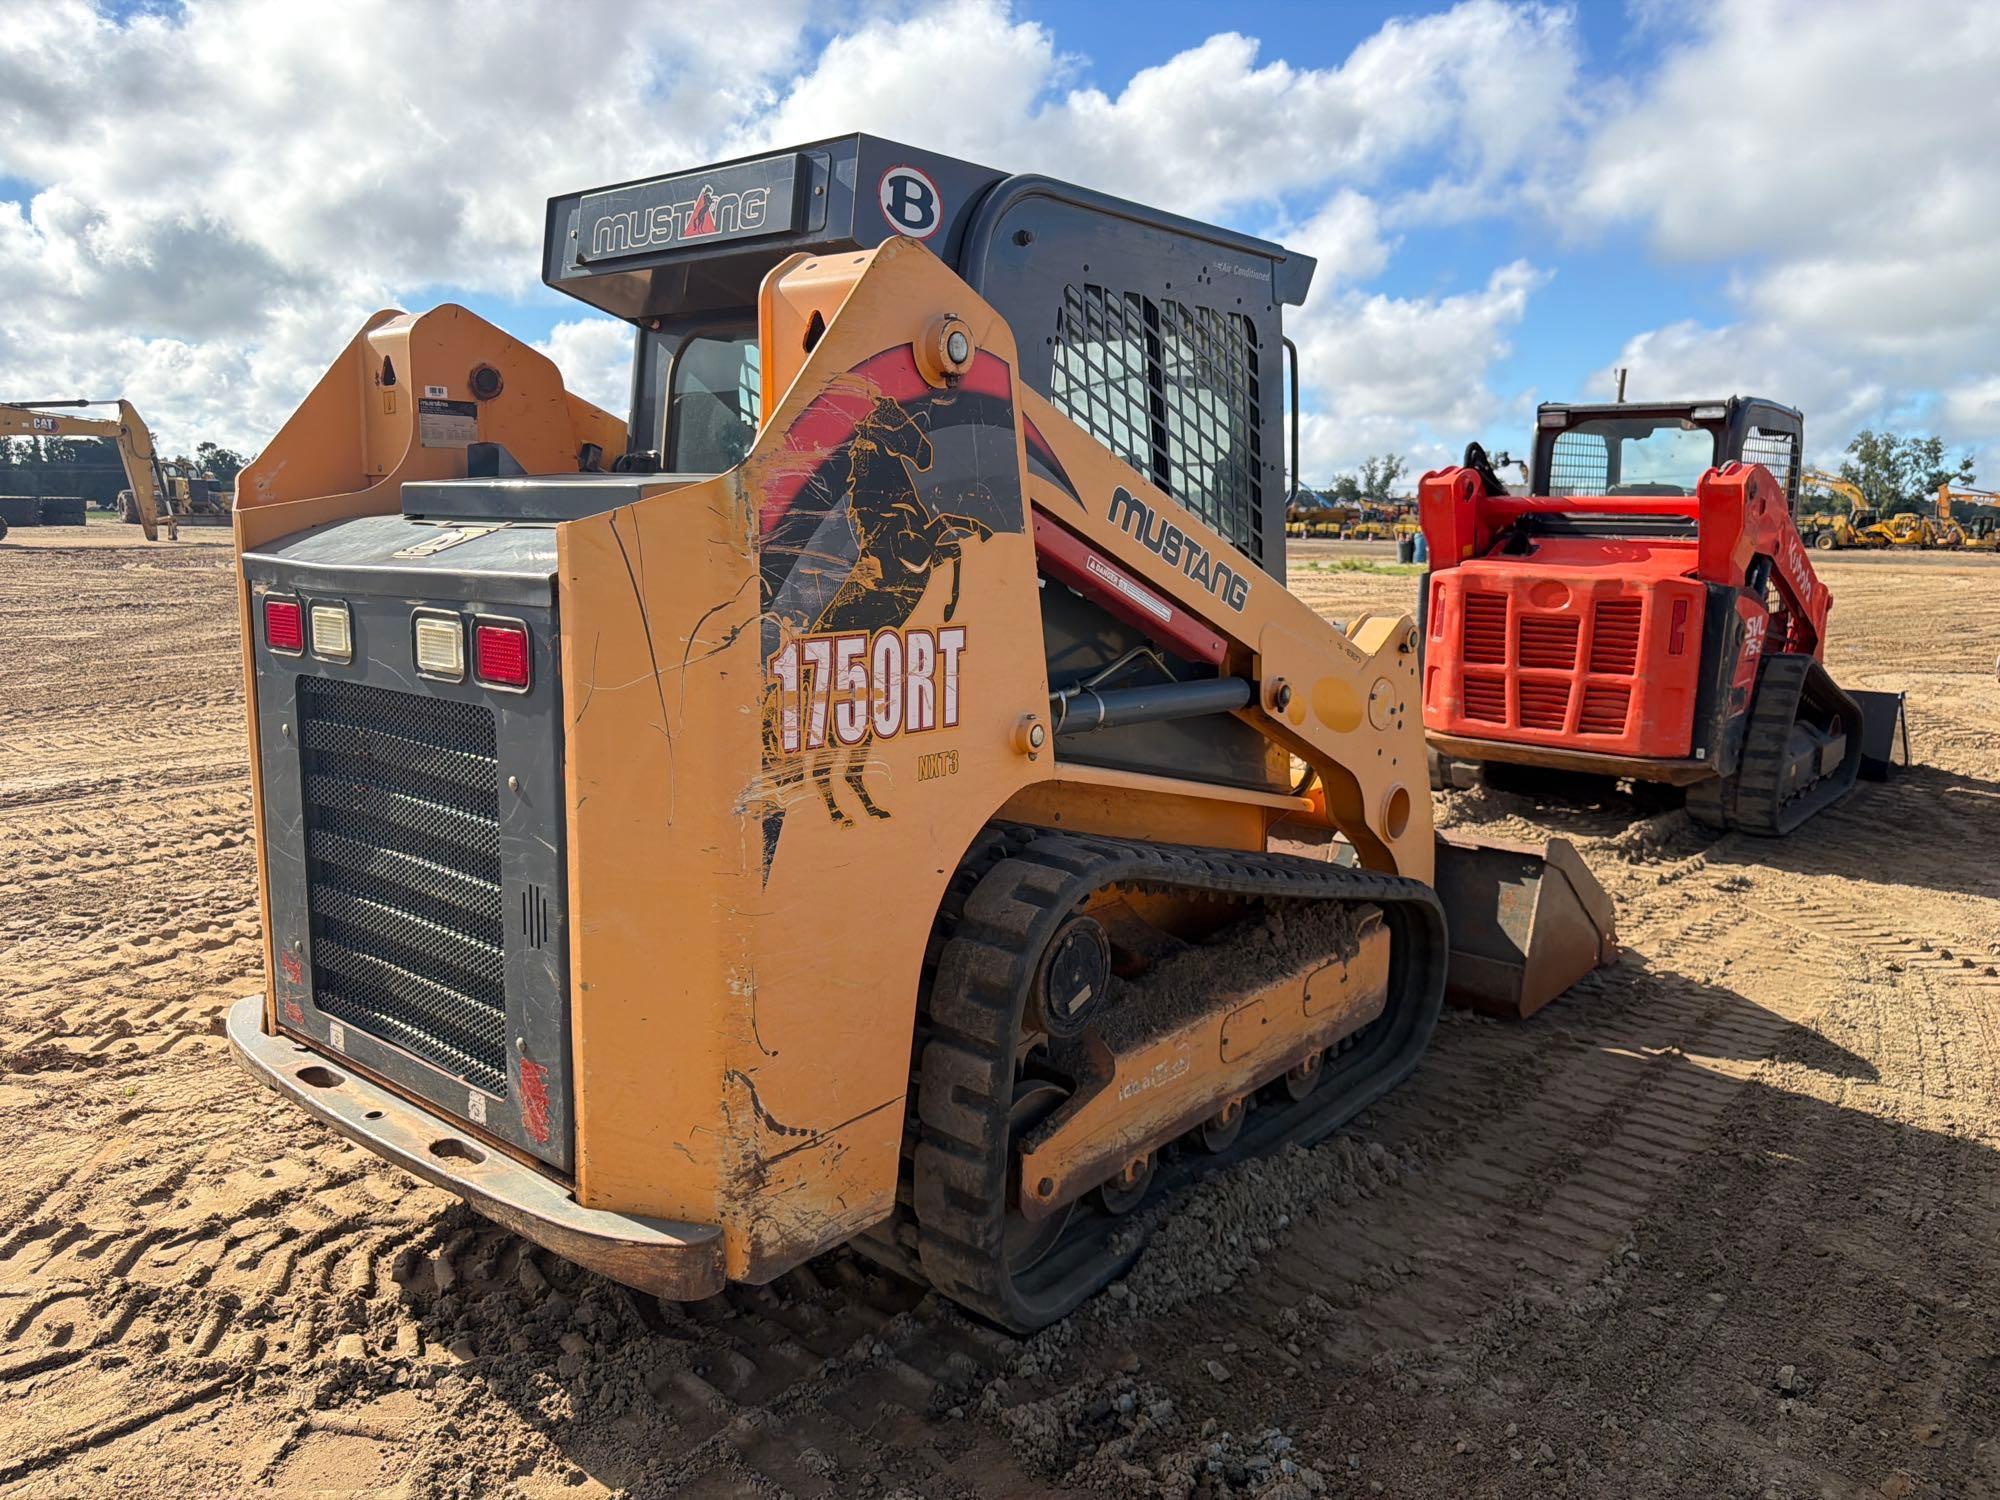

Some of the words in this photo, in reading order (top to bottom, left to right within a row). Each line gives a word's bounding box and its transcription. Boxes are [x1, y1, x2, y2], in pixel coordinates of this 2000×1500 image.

[592, 184, 770, 254] MUSTANG
[886, 175, 934, 230] B
[33, 417, 53, 430] CAT
[1107, 485, 1249, 614] MUSTANG
[1096, 564, 1119, 585] DANGER
[1744, 615, 1765, 640] SVL
[770, 625, 967, 753] 1750RT
[918, 750, 959, 782] NXT3
